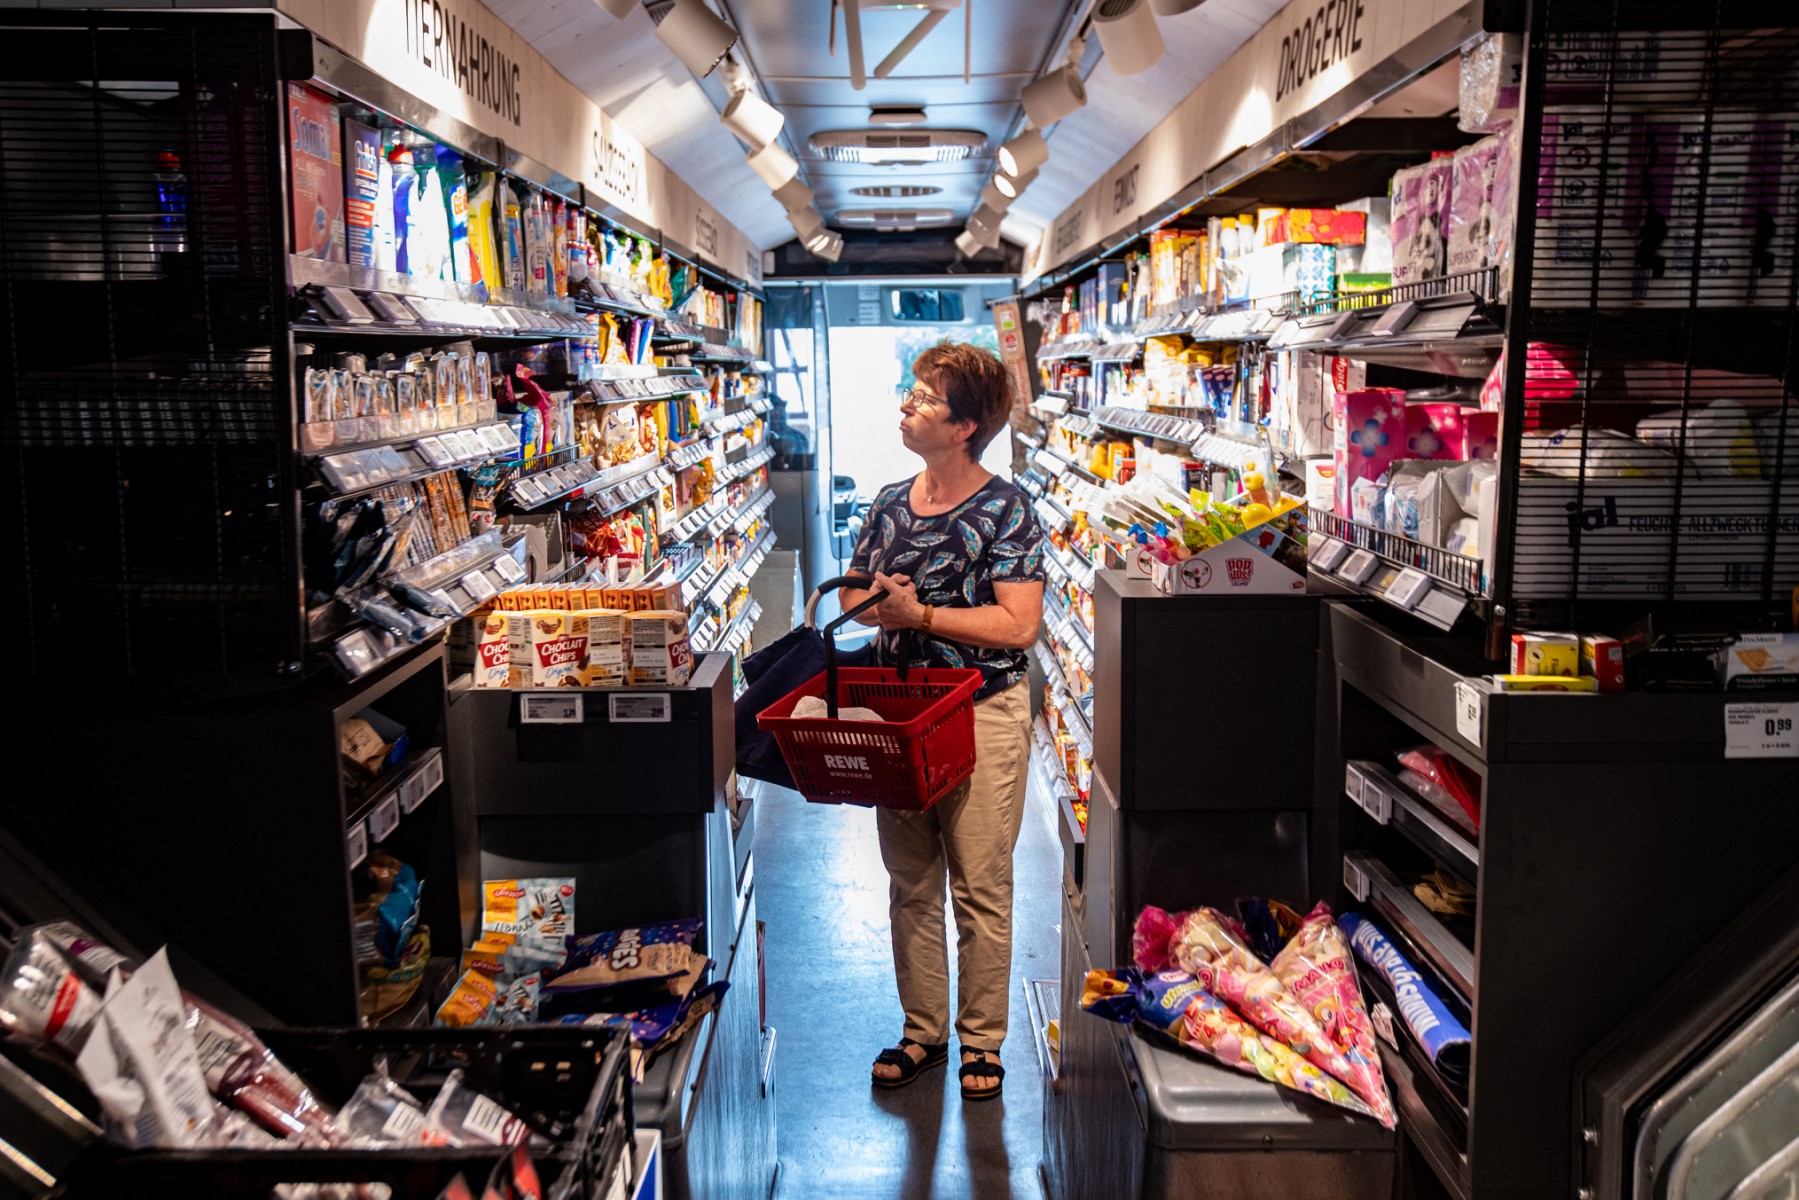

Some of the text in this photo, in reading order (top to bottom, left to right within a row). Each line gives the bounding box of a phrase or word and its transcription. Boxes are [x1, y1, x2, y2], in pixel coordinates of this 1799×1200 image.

[1275, 0, 1365, 103] DROGERIE
[1566, 496, 1618, 548] ja!
[541, 639, 584, 657] CHOCLAIT
[550, 651, 576, 665] CHIPS
[1765, 718, 1792, 737] 0.99
[824, 754, 870, 771] REWE
[829, 771, 872, 780] www.rewe.de
[1294, 957, 1345, 992] MALLO
